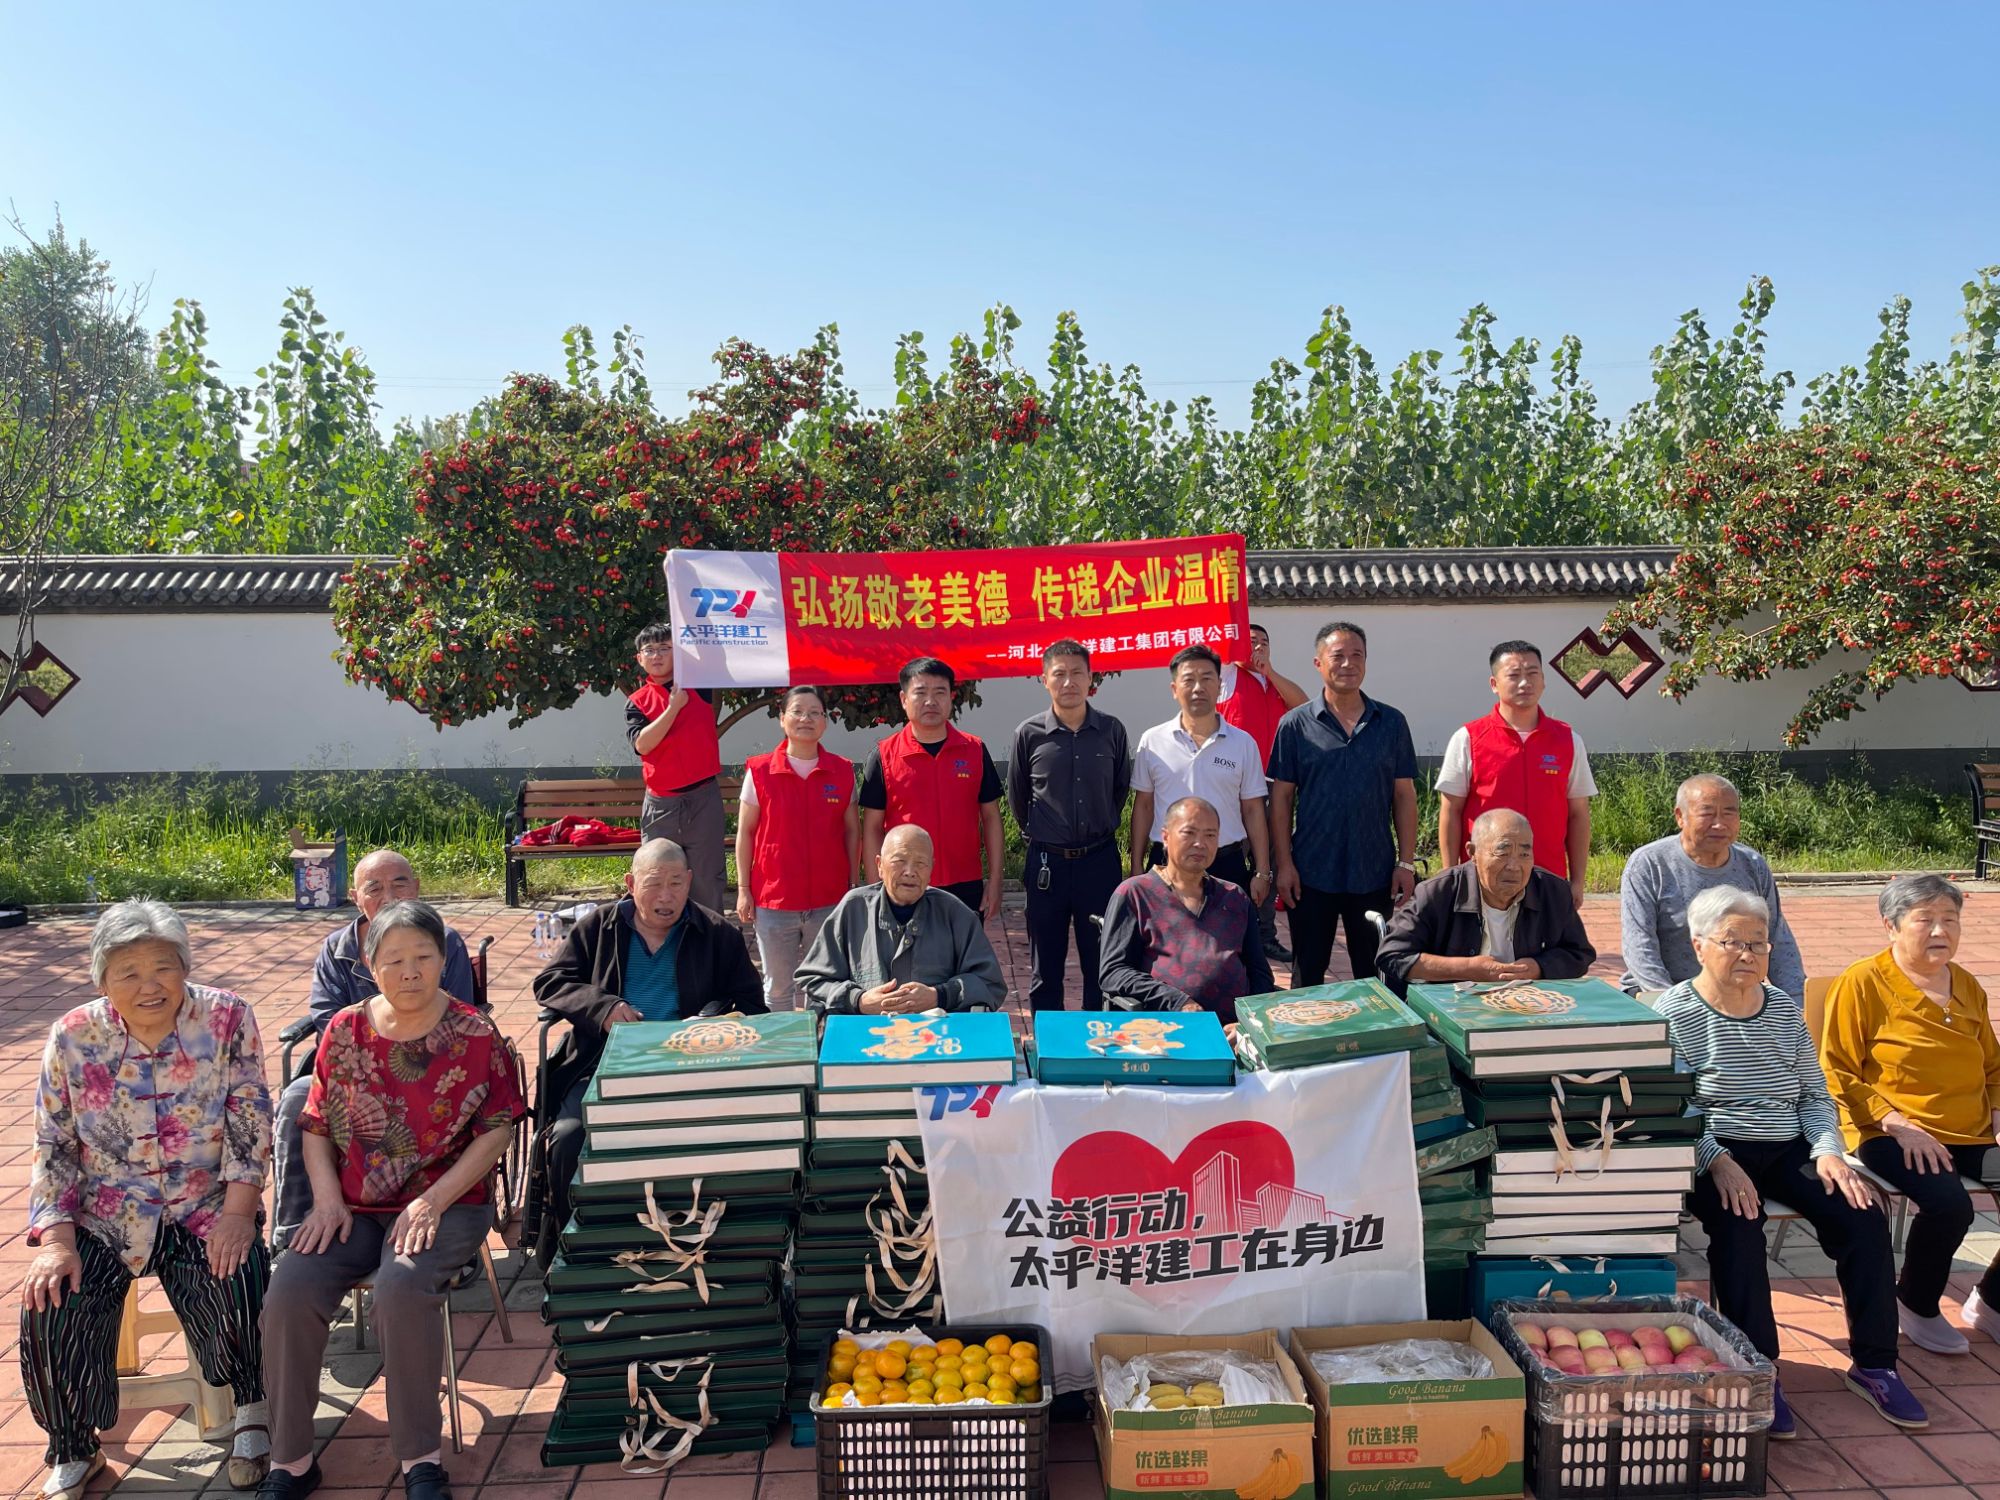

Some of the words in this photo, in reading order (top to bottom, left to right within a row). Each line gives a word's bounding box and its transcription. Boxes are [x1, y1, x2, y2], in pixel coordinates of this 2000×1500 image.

[791, 570, 1011, 630] 弘扬敬老美德
[1031, 546, 1241, 622] 传递企业温情
[680, 624, 768, 638] 太平洋建工
[1213, 756, 1237, 769] BOSS
[1010, 1214, 1384, 1290] 太平洋建工在身边
[1389, 1382, 1418, 1399] Good
[1422, 1382, 1466, 1395] Banana
[1214, 1408, 1258, 1420] Banana
[1347, 1425, 1419, 1445] 优选鲜果
[1136, 1450, 1209, 1469] 优选鲜果
[1348, 1478, 1381, 1496] Good
[1385, 1477, 1432, 1492] Banana
